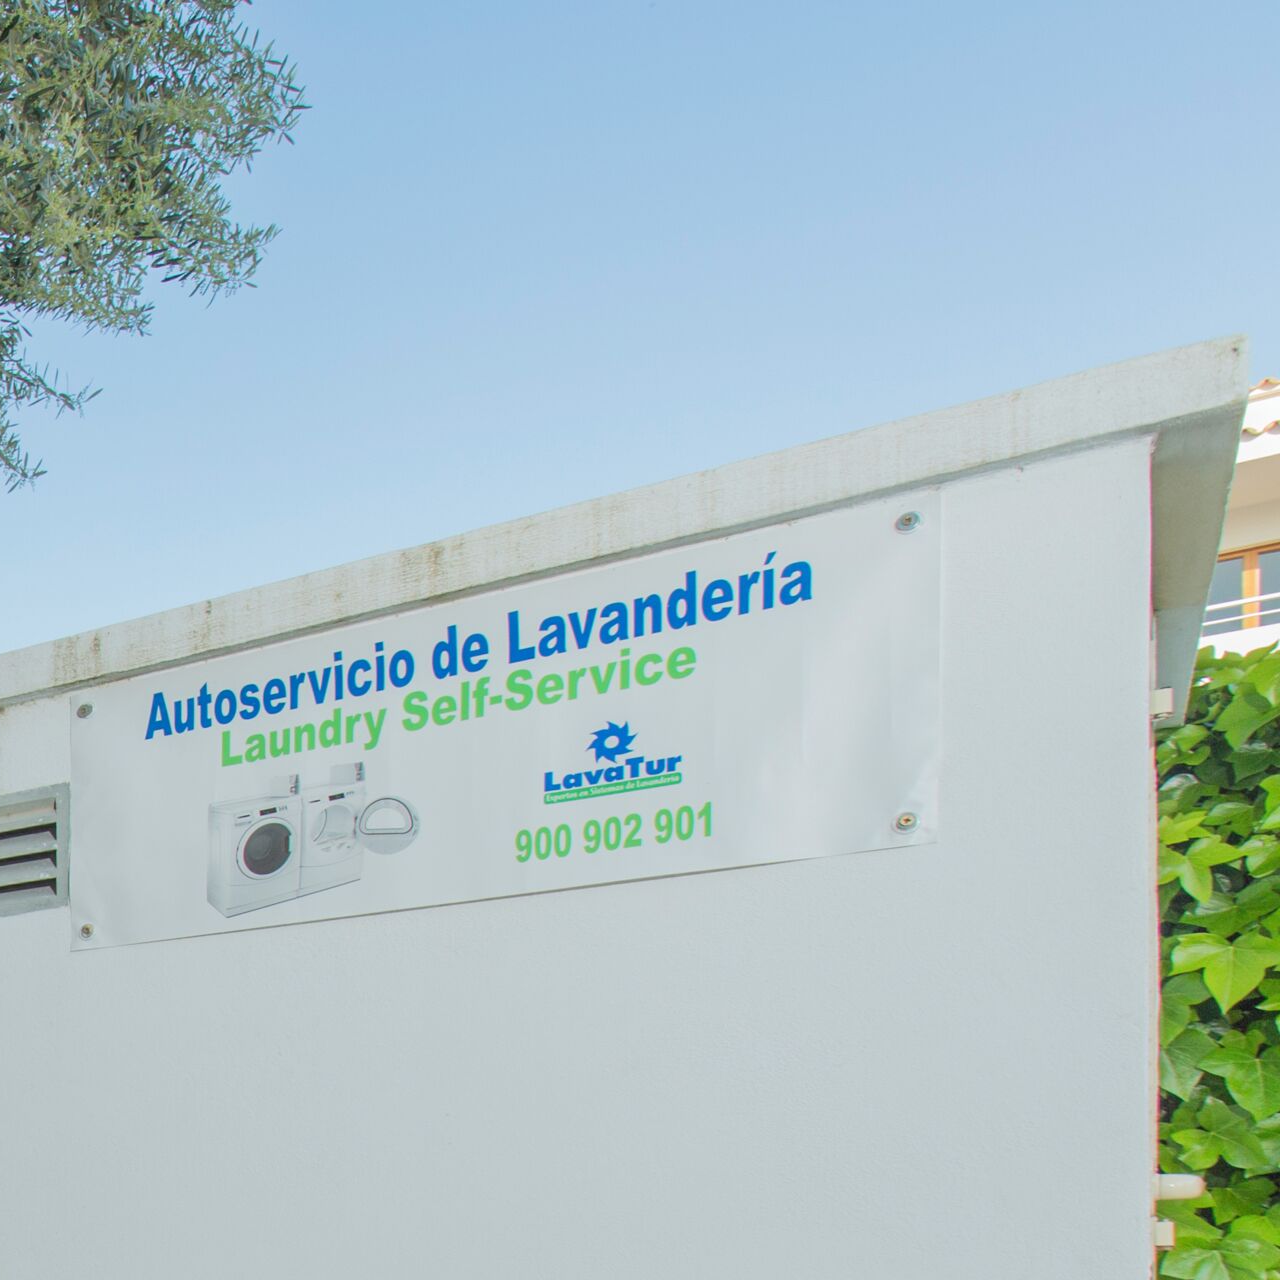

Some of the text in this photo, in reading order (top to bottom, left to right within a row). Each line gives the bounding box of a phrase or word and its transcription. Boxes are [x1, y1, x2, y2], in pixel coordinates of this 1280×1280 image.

[145, 551, 814, 740] Autoservicio de Lavandería
[221, 646, 698, 767] Laundry Self-Service
[544, 755, 683, 792] LavaTur
[546, 791, 578, 802] Expertos
[579, 790, 588, 798] en
[590, 784, 624, 795] Sistemas
[625, 780, 635, 789] de
[514, 800, 714, 863] 900 902 901
